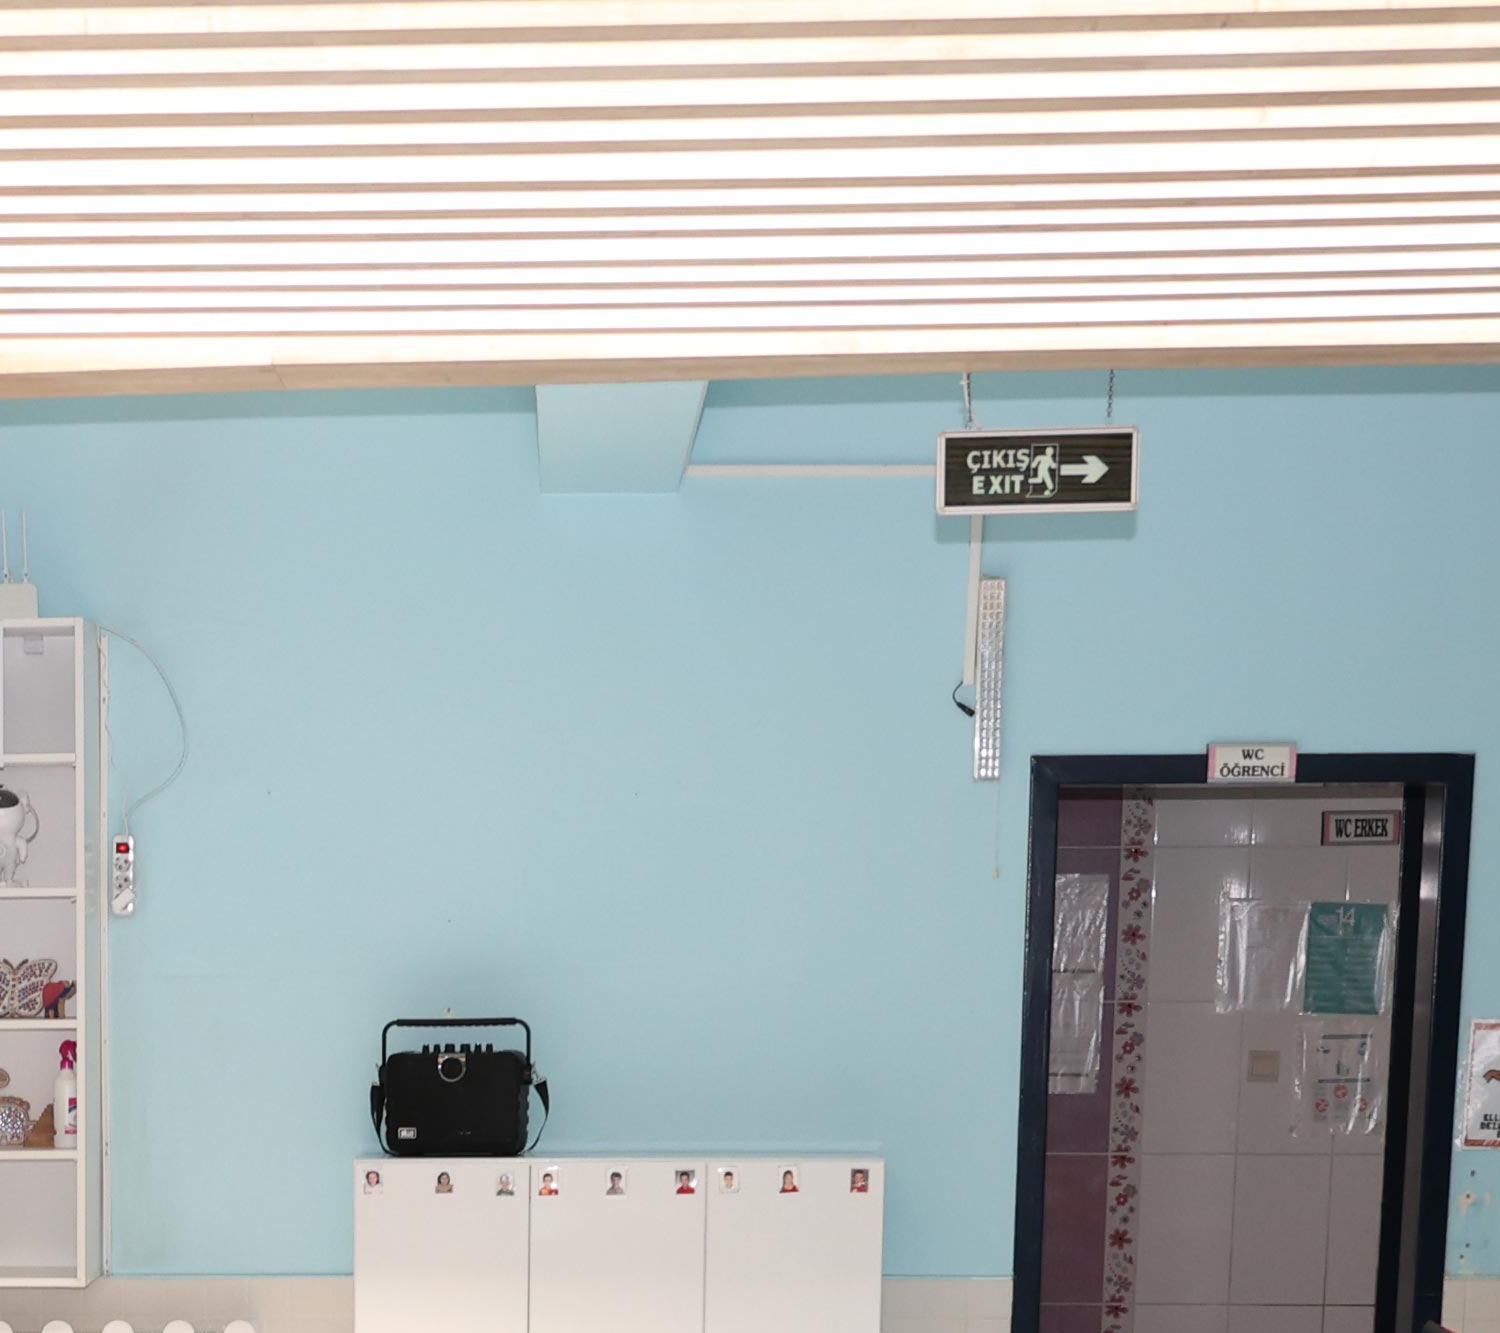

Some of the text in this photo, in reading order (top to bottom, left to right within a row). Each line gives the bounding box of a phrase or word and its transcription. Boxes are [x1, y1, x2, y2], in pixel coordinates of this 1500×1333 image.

[966, 449, 1031, 474] ÇIKIŞ
[972, 475, 1026, 496] EXIT
[1241, 749, 1265, 761] WC
[1219, 761, 1286, 777] ÖĞRENCİ
[1334, 818, 1389, 838] WC ERKEK
